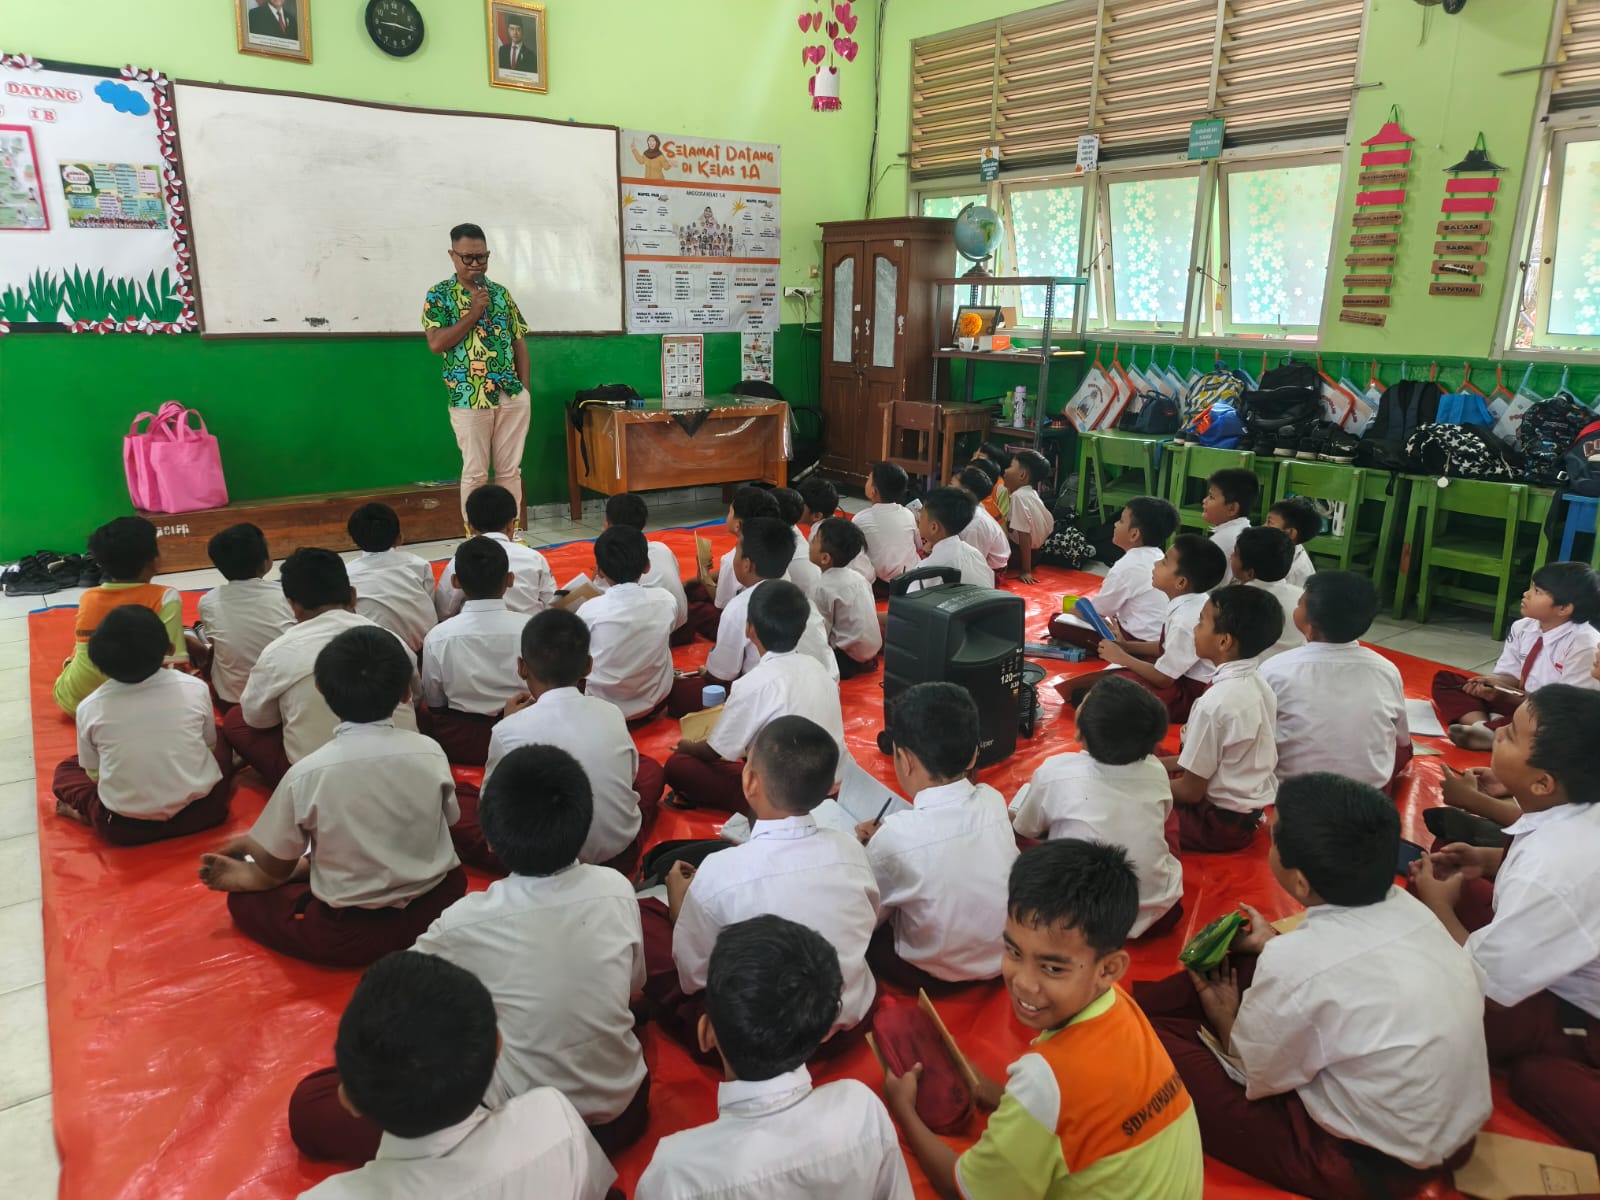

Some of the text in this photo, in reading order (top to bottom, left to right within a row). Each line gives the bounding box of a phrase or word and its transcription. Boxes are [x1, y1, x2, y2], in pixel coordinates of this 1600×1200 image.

[7, 82, 78, 101] DATANG
[662, 141, 774, 163] SELAMAT DATANG
[681, 162, 693, 174] DI
[697, 160, 735, 178] KELAS
[1000, 672, 1013, 685] 120
